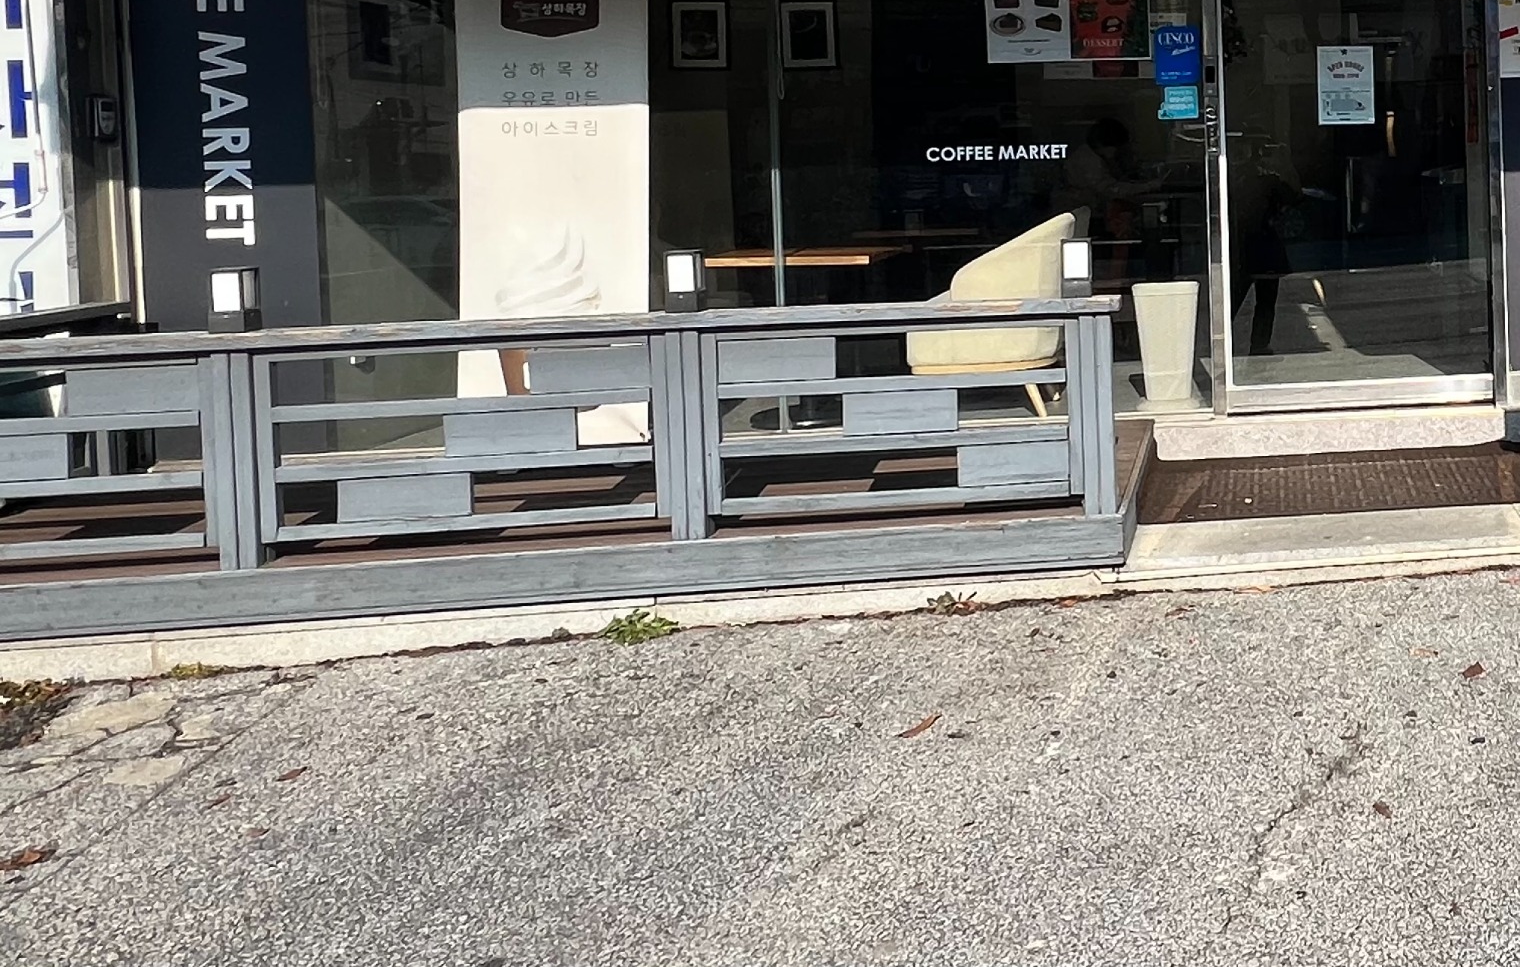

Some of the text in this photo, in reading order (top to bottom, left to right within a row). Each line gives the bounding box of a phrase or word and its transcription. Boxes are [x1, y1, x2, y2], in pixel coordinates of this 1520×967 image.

[502, 91, 600, 106] 우유로 만든
[501, 120, 598, 137] 아이스크림
[197, 30, 257, 247] MARKET
[926, 144, 1068, 162] COFFEE MARKET
